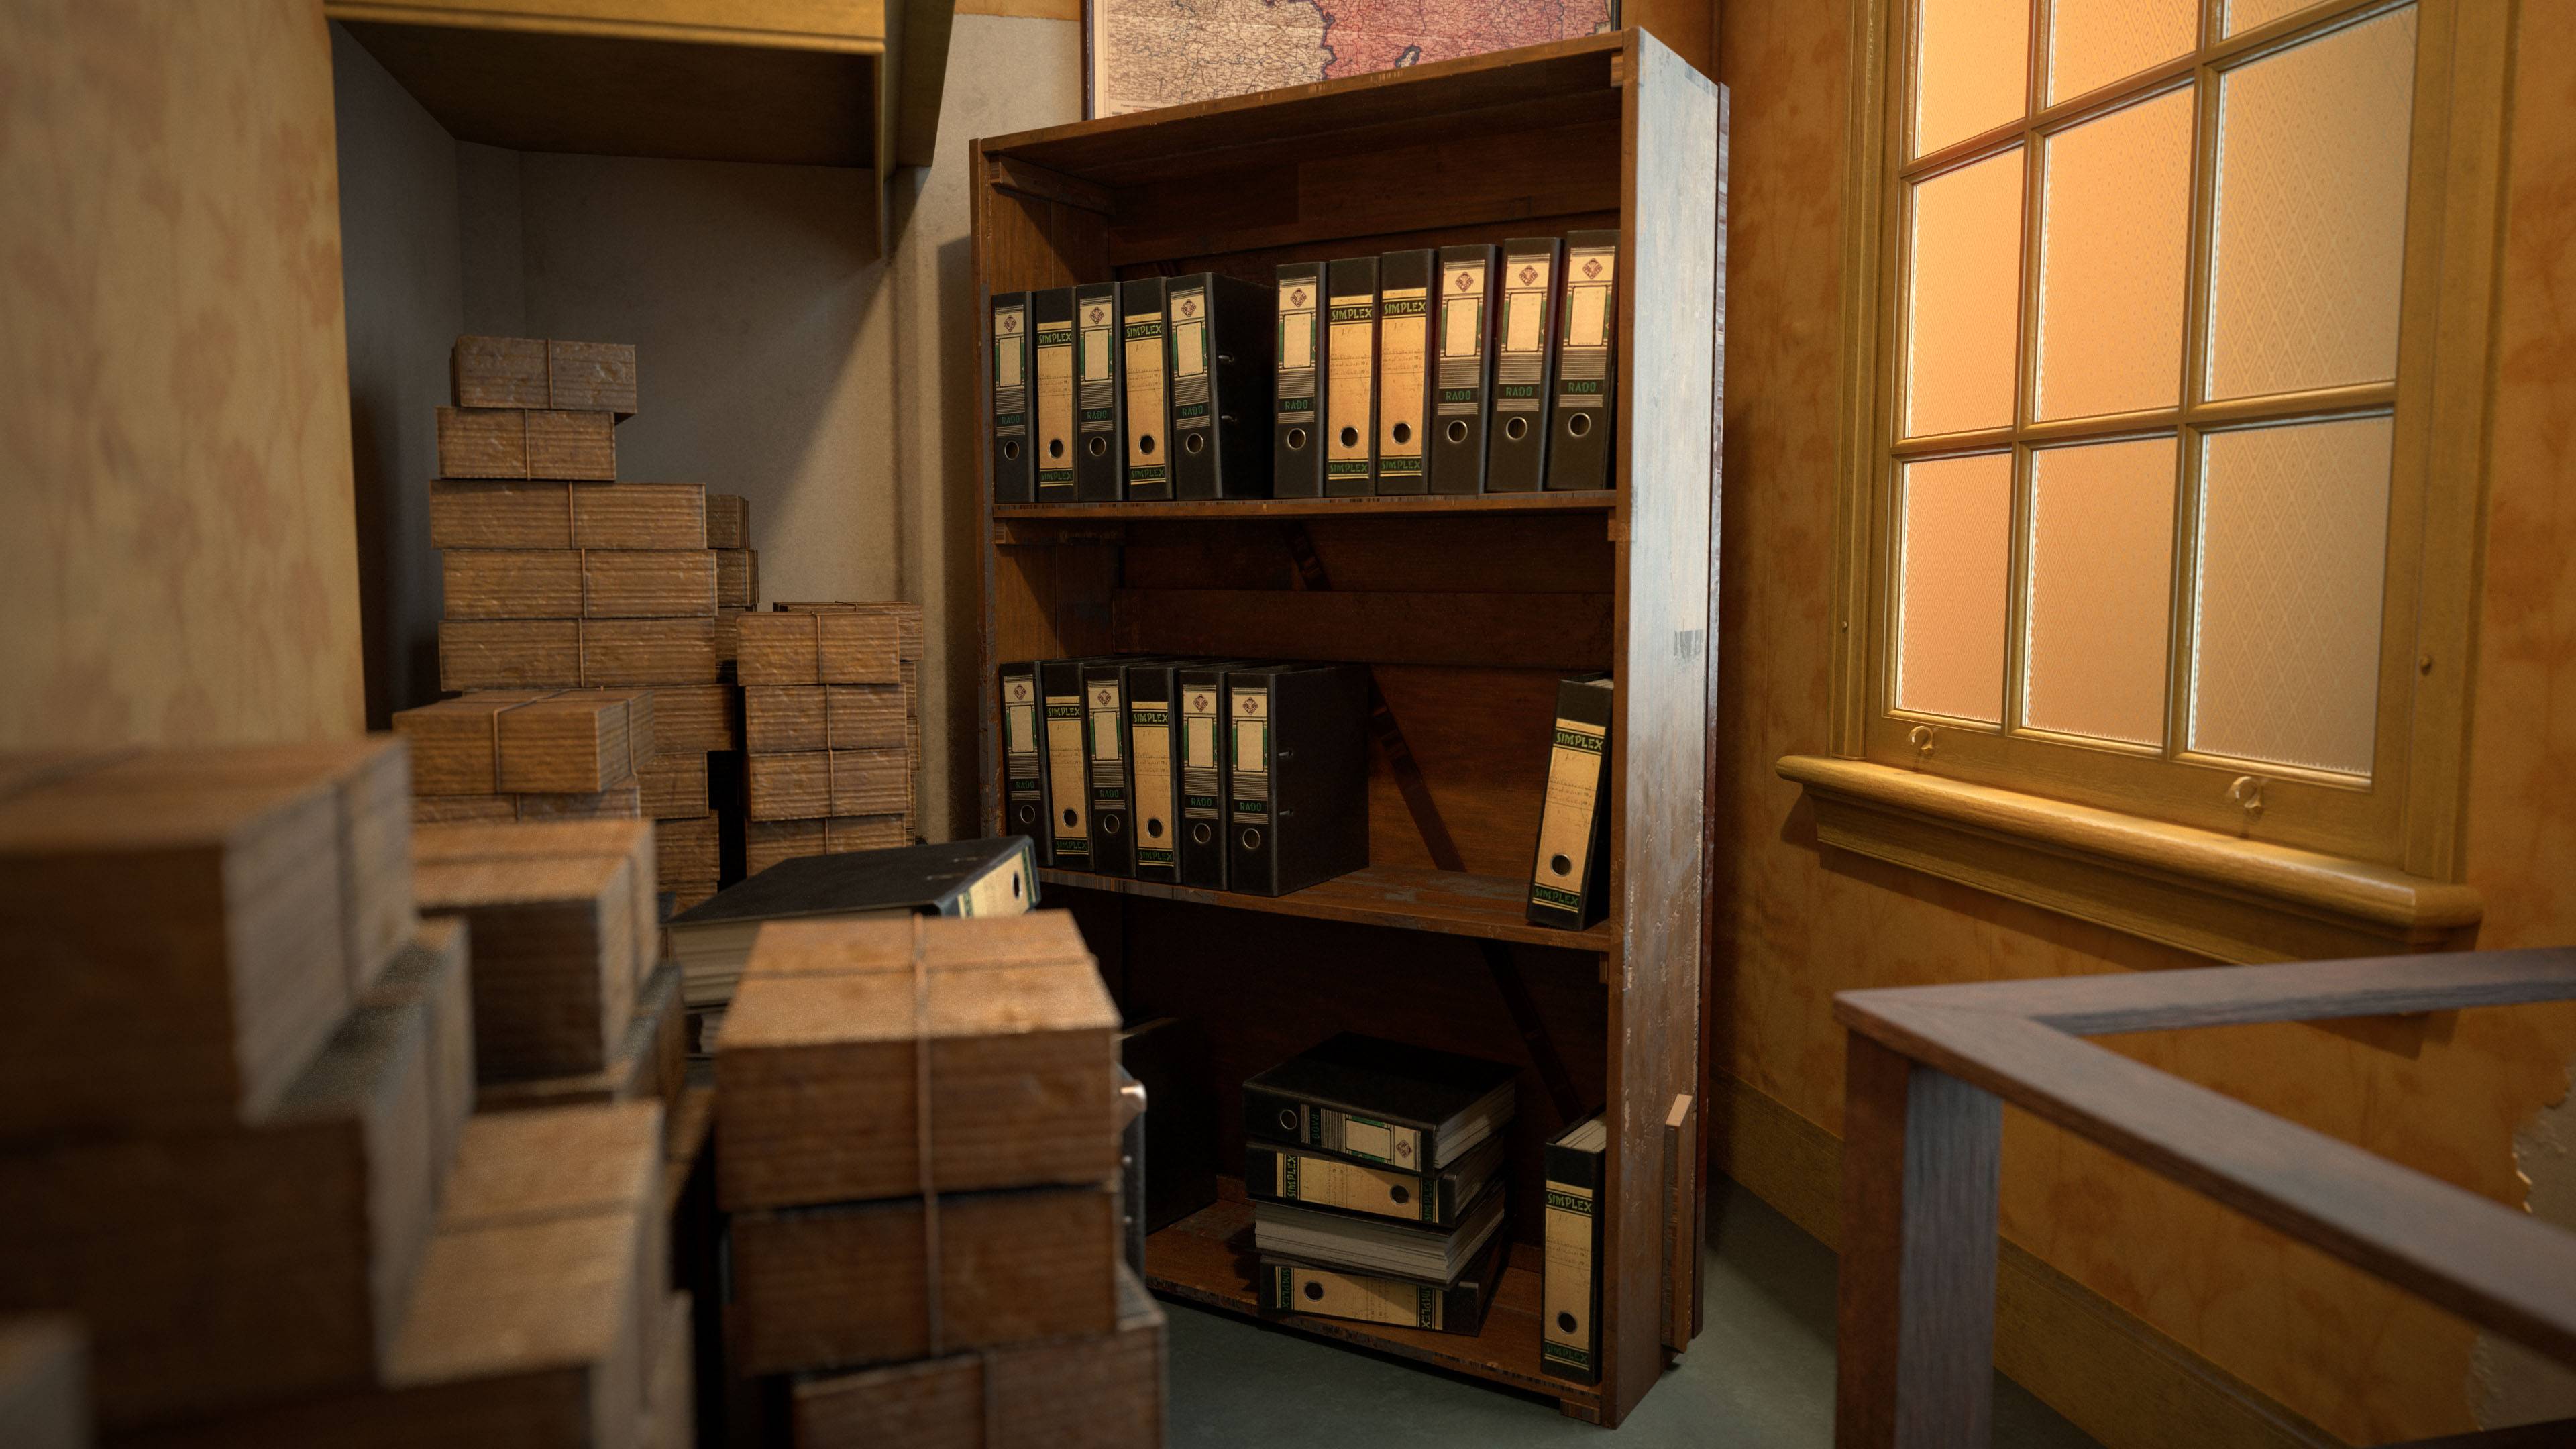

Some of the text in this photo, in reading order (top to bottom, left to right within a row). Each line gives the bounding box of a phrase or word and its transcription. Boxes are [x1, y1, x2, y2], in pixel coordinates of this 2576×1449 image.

[1384, 301, 1426, 315] SIMPLEX
[1332, 307, 1372, 321] SIMPLEX
[1126, 325, 1162, 337] SIMPLEX
[1038, 331, 1071, 344] SIMPLEX
[1505, 386, 1533, 396] RADO
[1568, 382, 1596, 392] RADO
[1446, 390, 1471, 400] RADO
[1285, 399, 1308, 410] RADO
[1087, 410, 1107, 420] RADO
[1181, 405, 1203, 416] RADO
[1001, 415, 1020, 424] RADO
[1330, 462, 1367, 473] SIMPLEX
[1381, 459, 1421, 470] SIMPLEX
[1040, 471, 1072, 480] SIMPLEX
[1130, 468, 1165, 478] SIMPLEX
[1048, 706, 1080, 718] SIMPLEX
[1133, 712, 1168, 724] SIMPLEX
[1556, 732, 1603, 751] SIMPLEX
[1016, 780, 1034, 789] RADO
[1099, 790, 1119, 798] RADO
[1191, 797, 1212, 806] RADO
[1240, 802, 1262, 812] RADO
[1056, 840, 1087, 851] SIMPLEX
[1138, 851, 1173, 861] SIMPLEX
[1534, 888, 1578, 906] SIMPLEX
[1548, 1193, 1592, 1213] SIMPLEX
[1546, 1344, 1588, 1364] SIMPLEX
